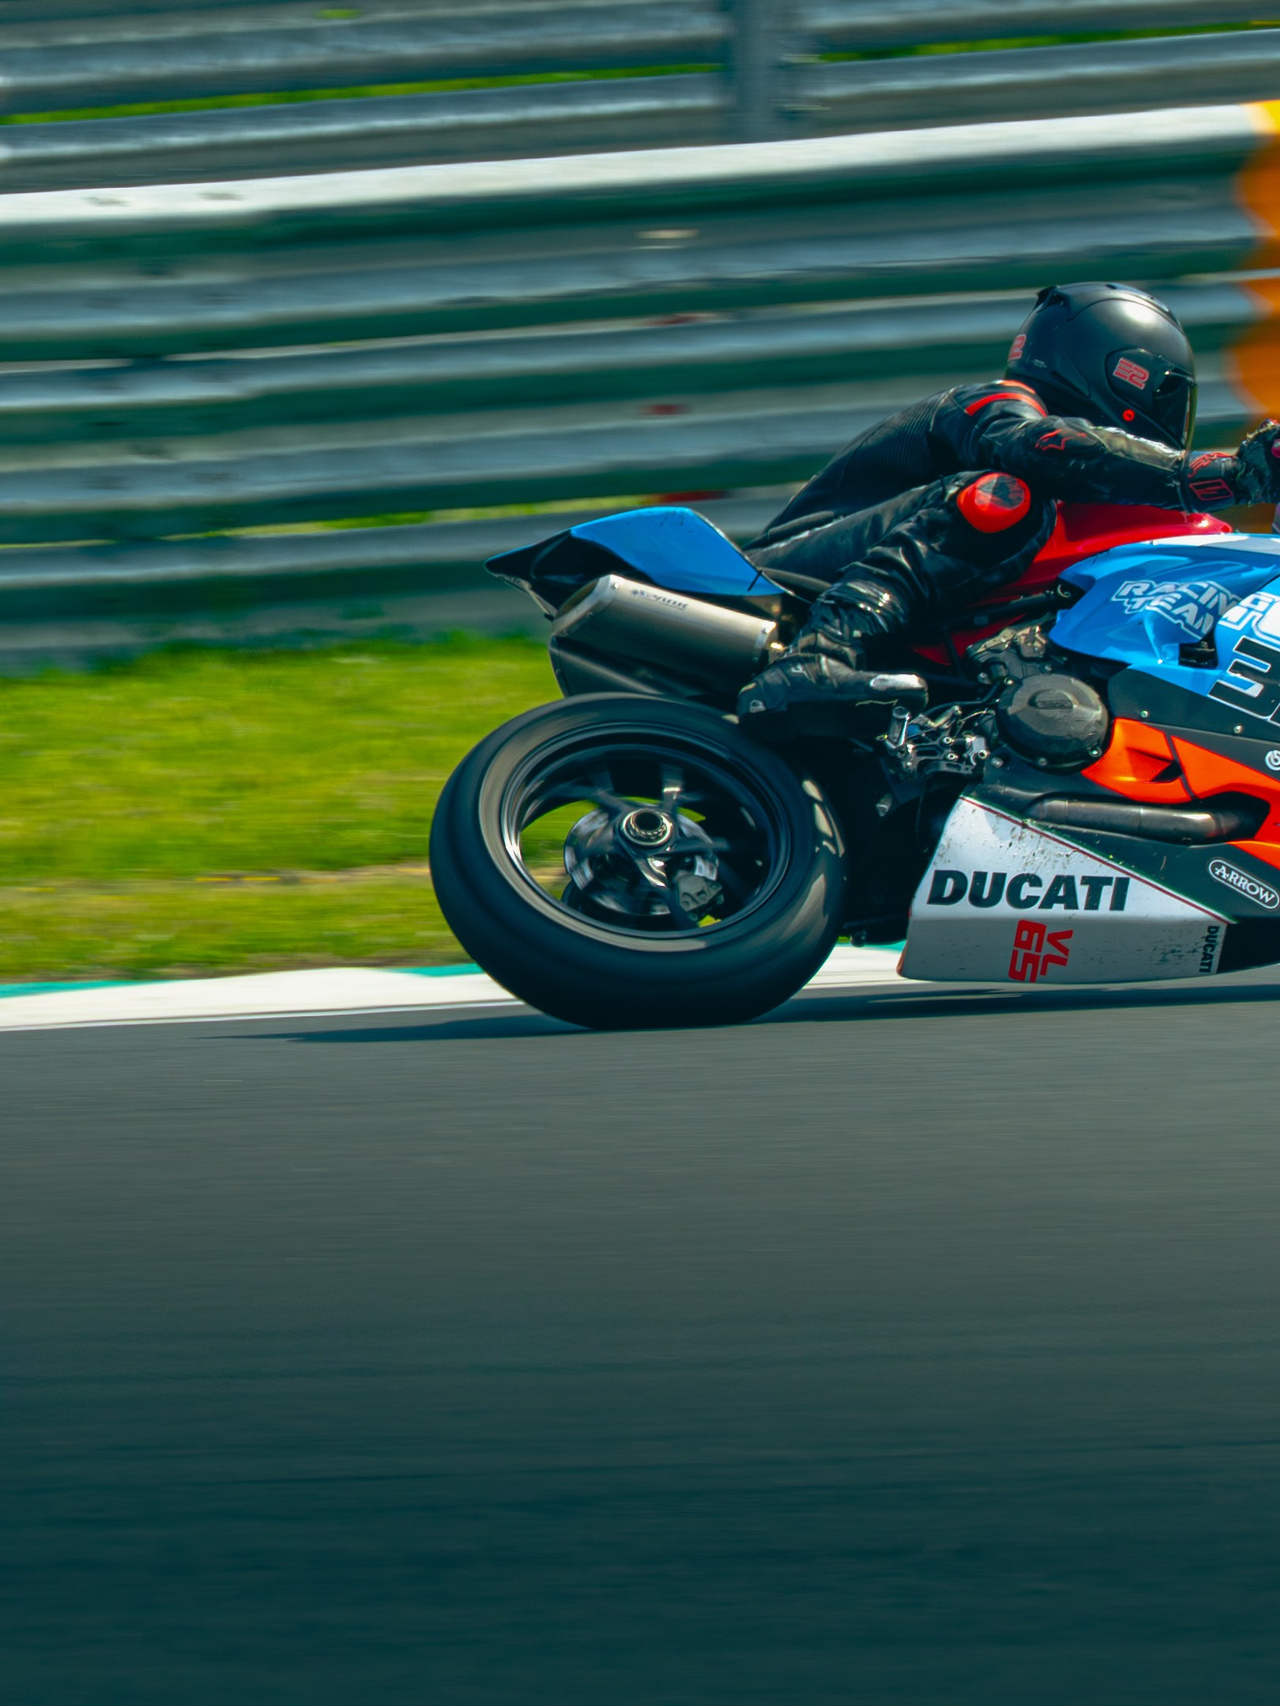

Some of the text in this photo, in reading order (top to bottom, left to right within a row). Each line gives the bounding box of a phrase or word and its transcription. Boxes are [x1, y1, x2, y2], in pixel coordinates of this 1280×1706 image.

[927, 869, 1131, 911] DUCATI
[1214, 865, 1275, 904] ARROW
[1008, 919, 1047, 983] 65
[1040, 929, 1073, 976] VL
[1199, 925, 1220, 973] DUCATI
